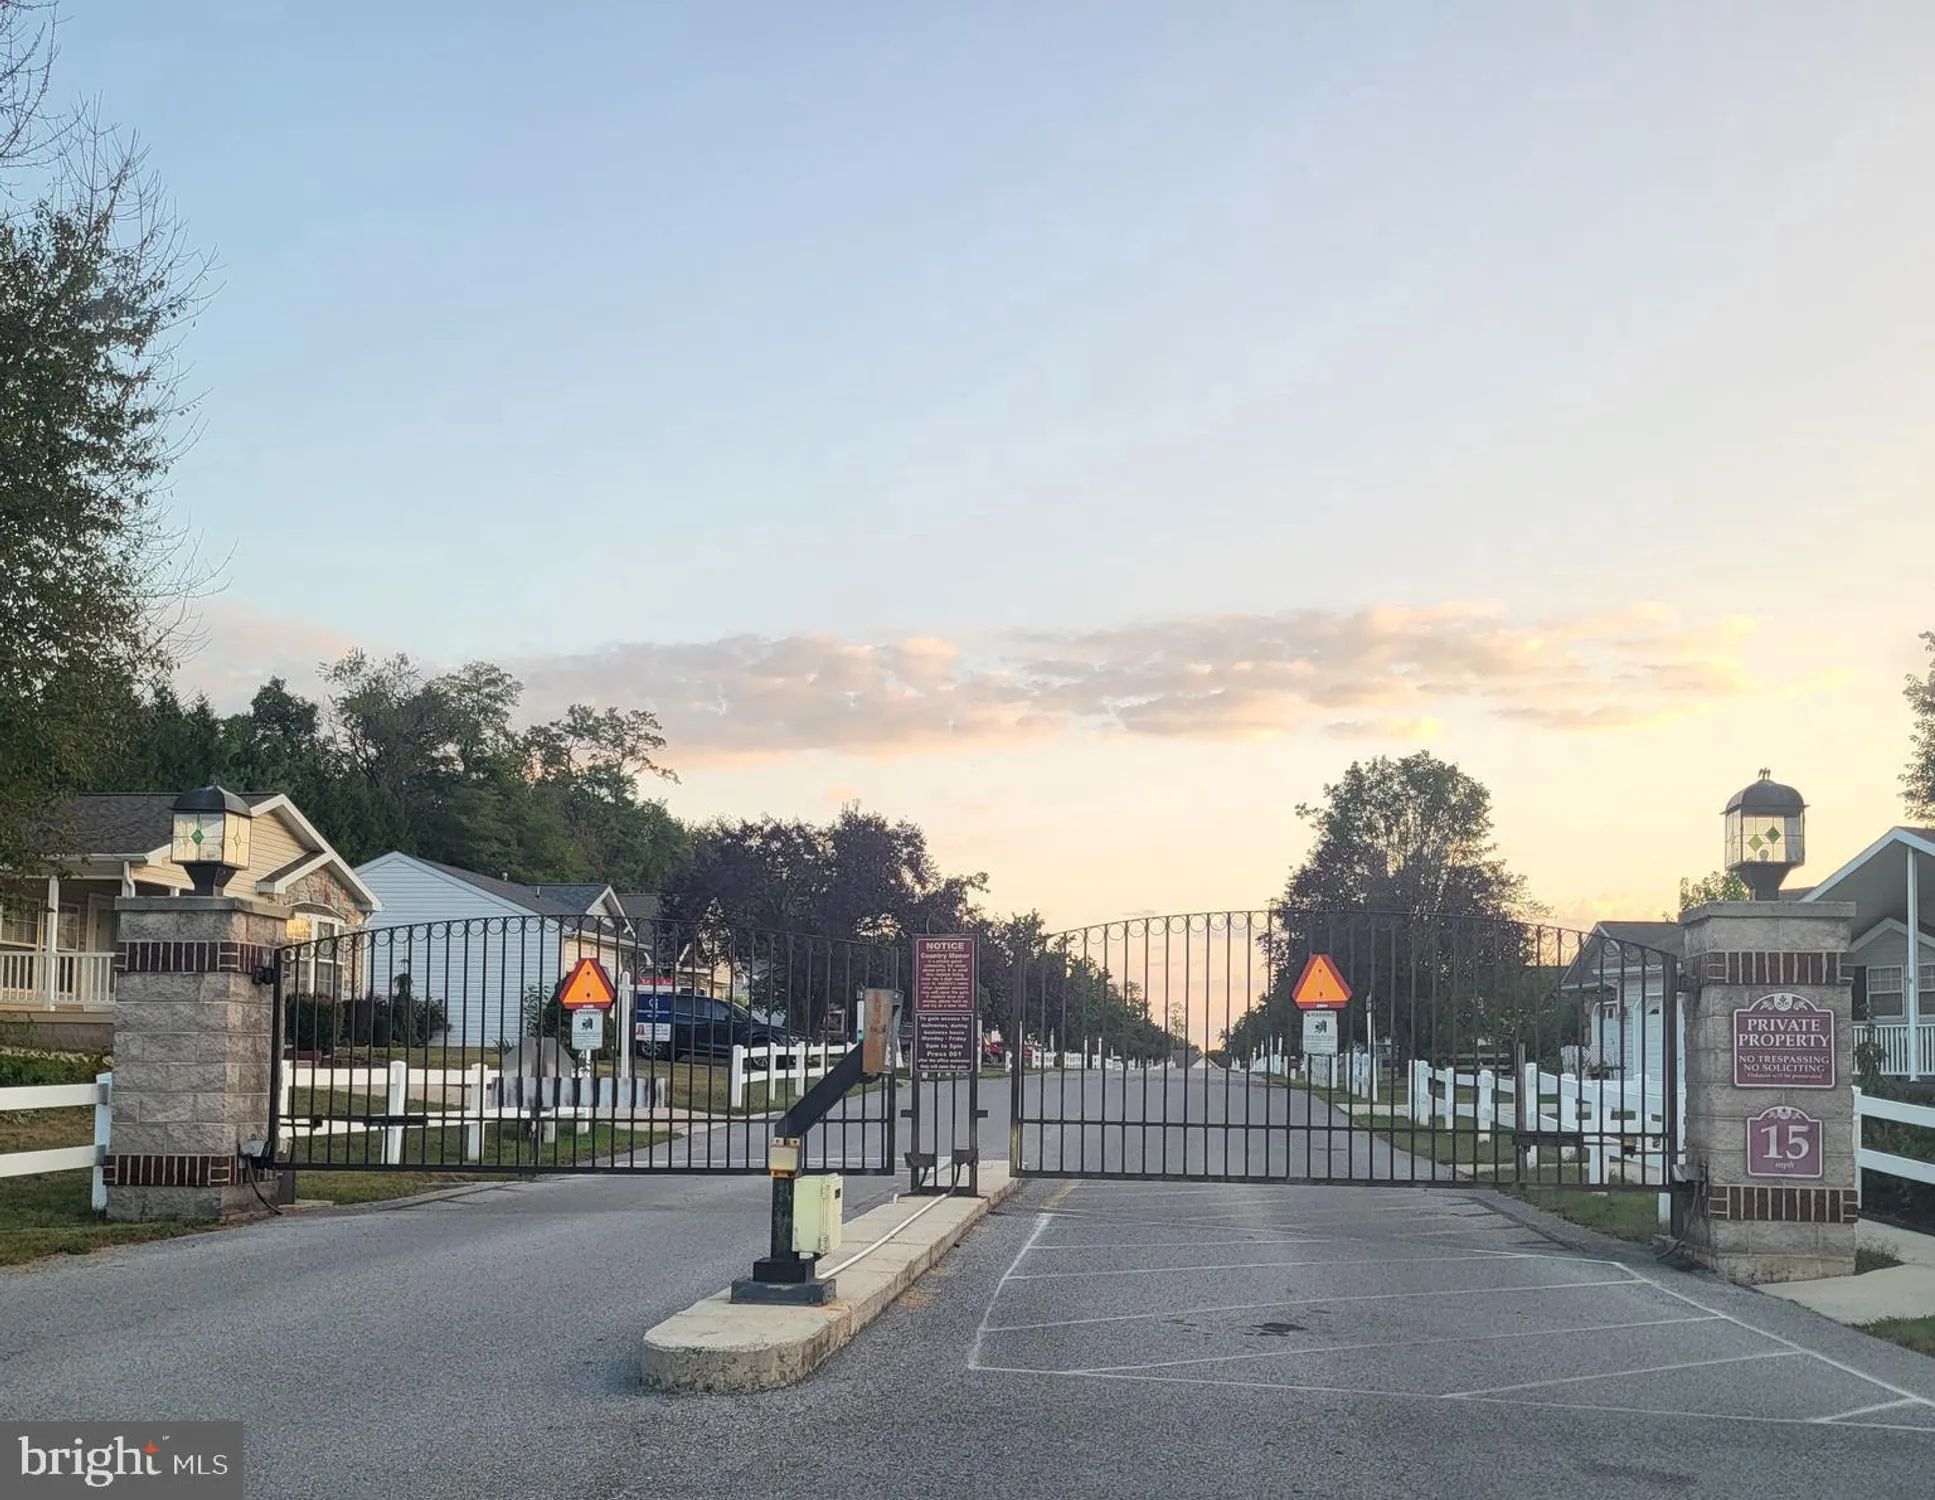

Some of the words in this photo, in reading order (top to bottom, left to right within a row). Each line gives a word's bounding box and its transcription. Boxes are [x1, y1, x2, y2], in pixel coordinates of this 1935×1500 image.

[926, 942, 965, 950] NOTICE
[920, 952, 947, 960] Country
[1747, 1019, 1821, 1032] PRIVATE
[1738, 1034, 1830, 1047] PROPERTY
[1739, 1055, 1755, 1063] NO
[1758, 1055, 1830, 1064] TRESPASSING
[1743, 1064, 1760, 1072] NO
[1762, 1064, 1825, 1072] SOLICITING
[1760, 1125, 1810, 1160] 15
[1774, 1161, 1795, 1170] mph
